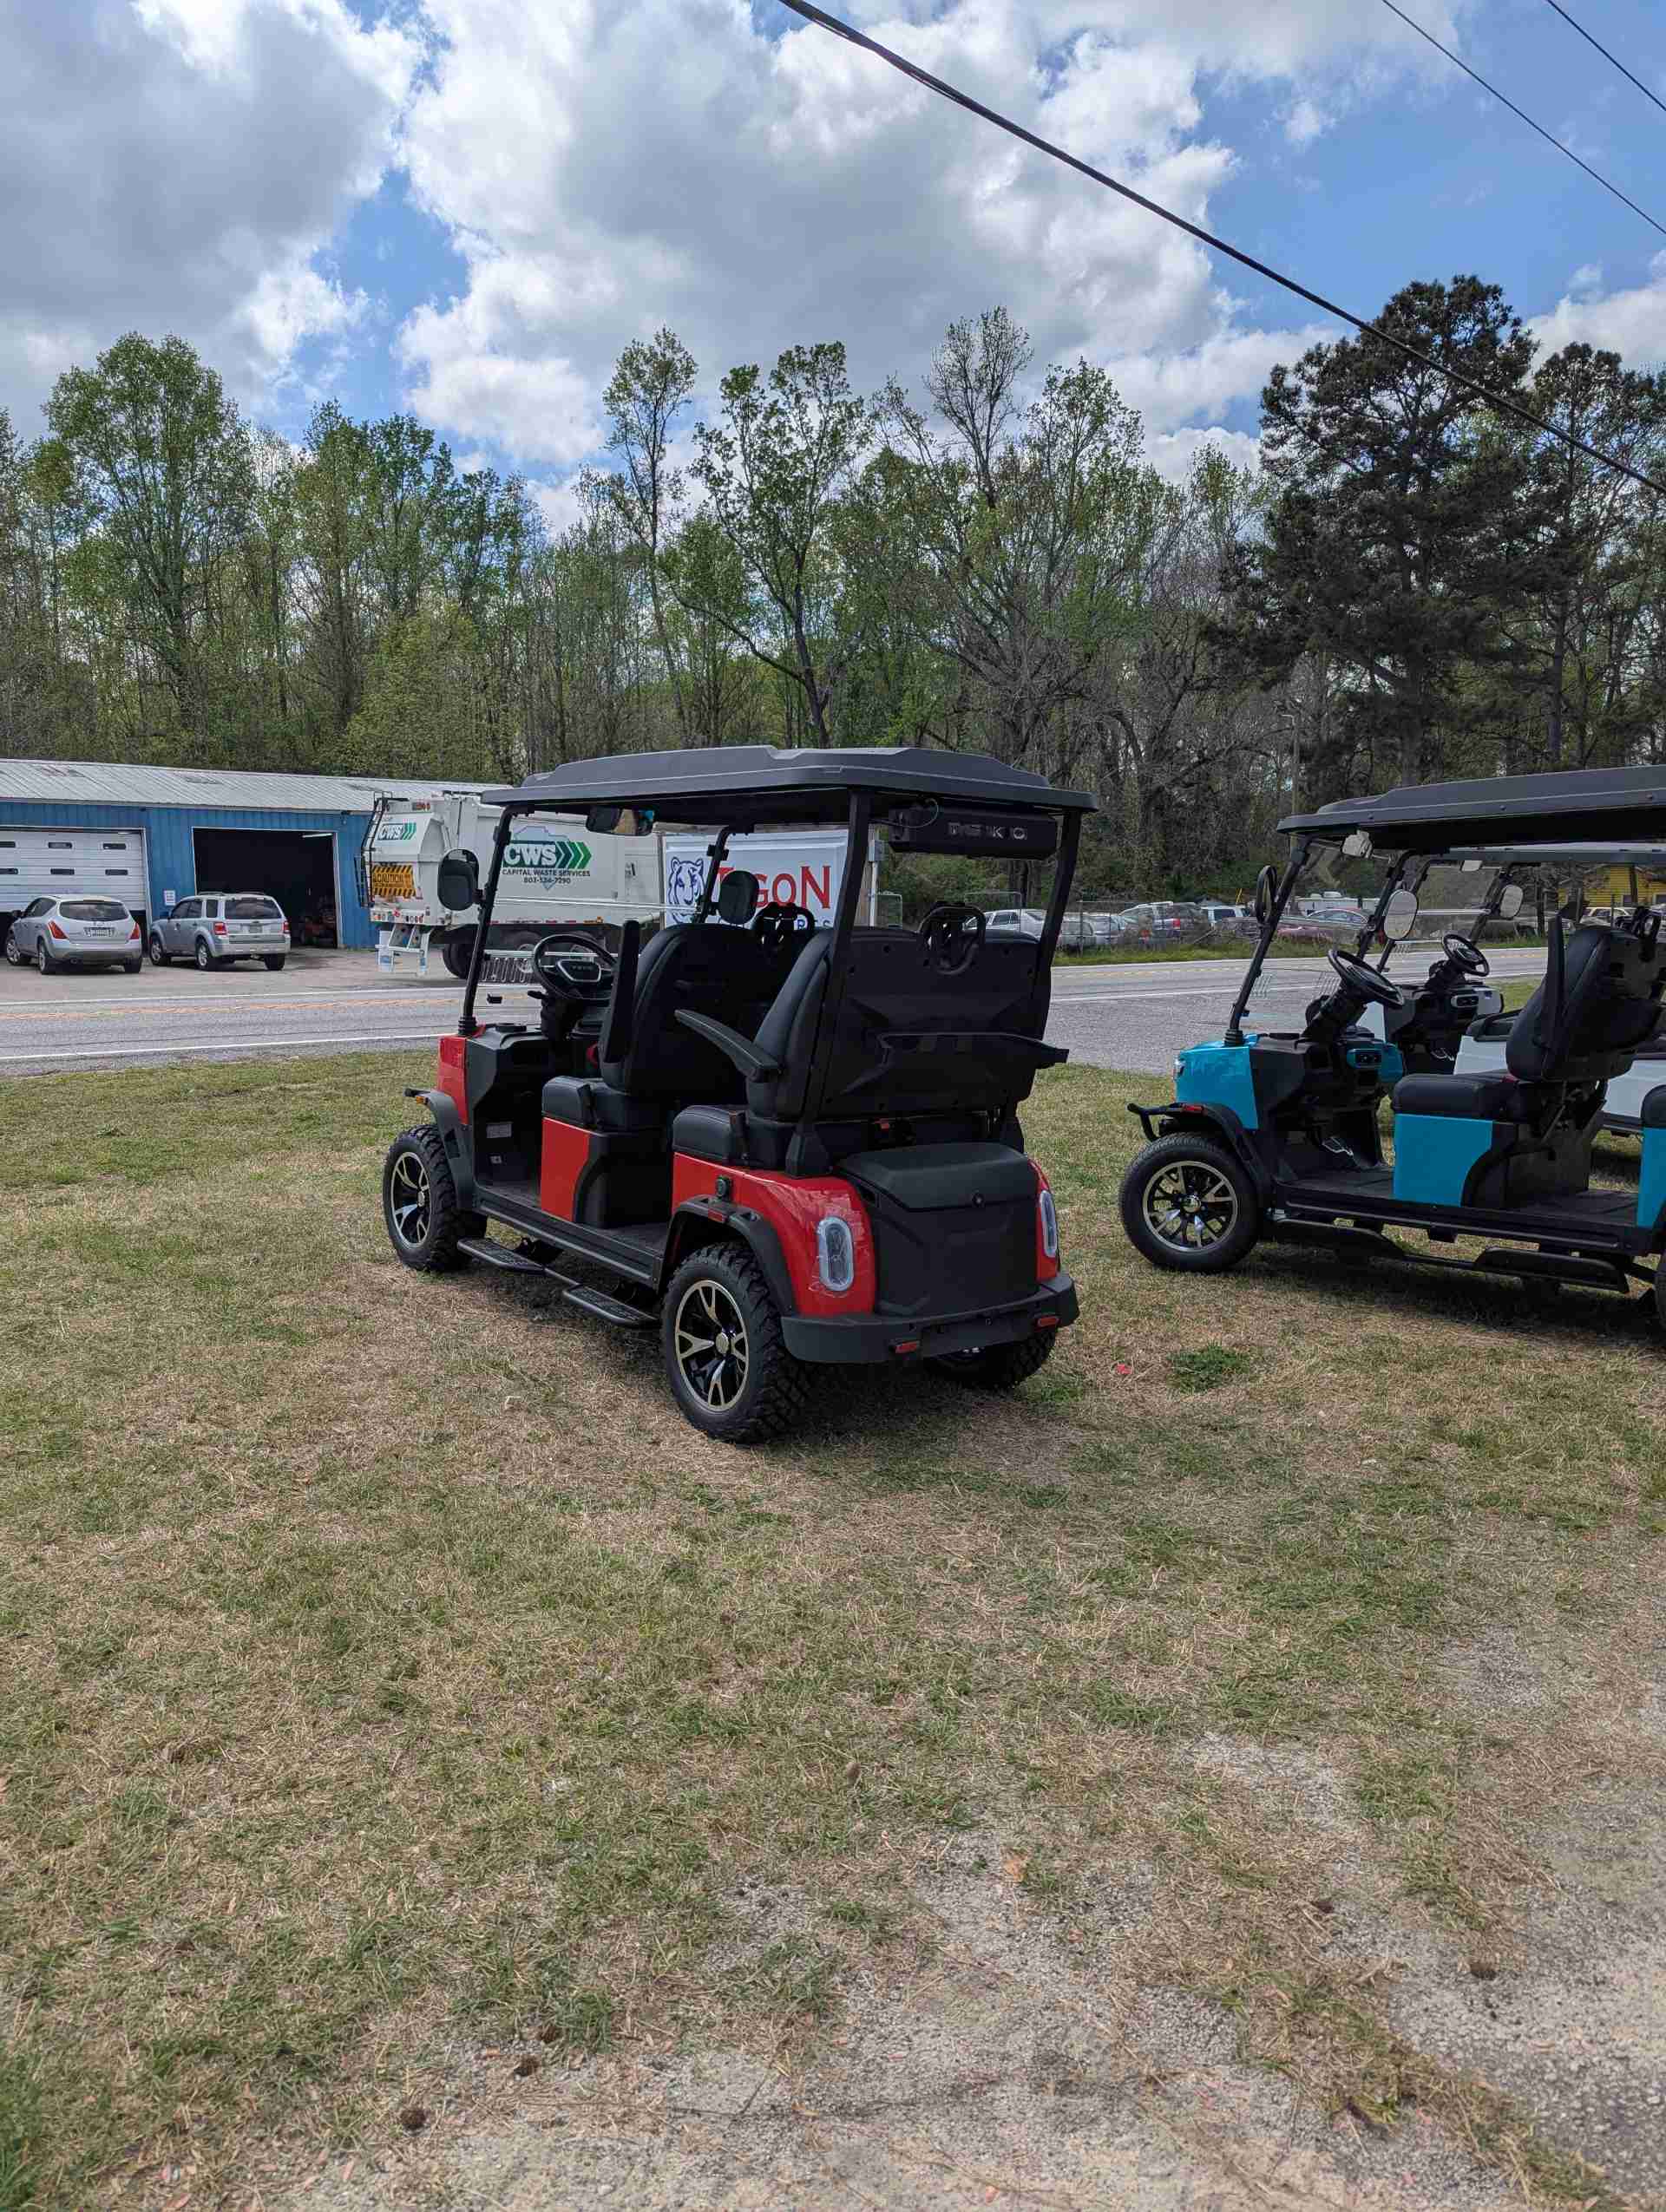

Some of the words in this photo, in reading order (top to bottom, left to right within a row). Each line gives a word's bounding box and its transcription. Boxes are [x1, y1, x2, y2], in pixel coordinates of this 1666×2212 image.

[503, 843, 557, 867] CWS
[533, 868, 557, 877] WASTE
[714, 865, 832, 910] GON
